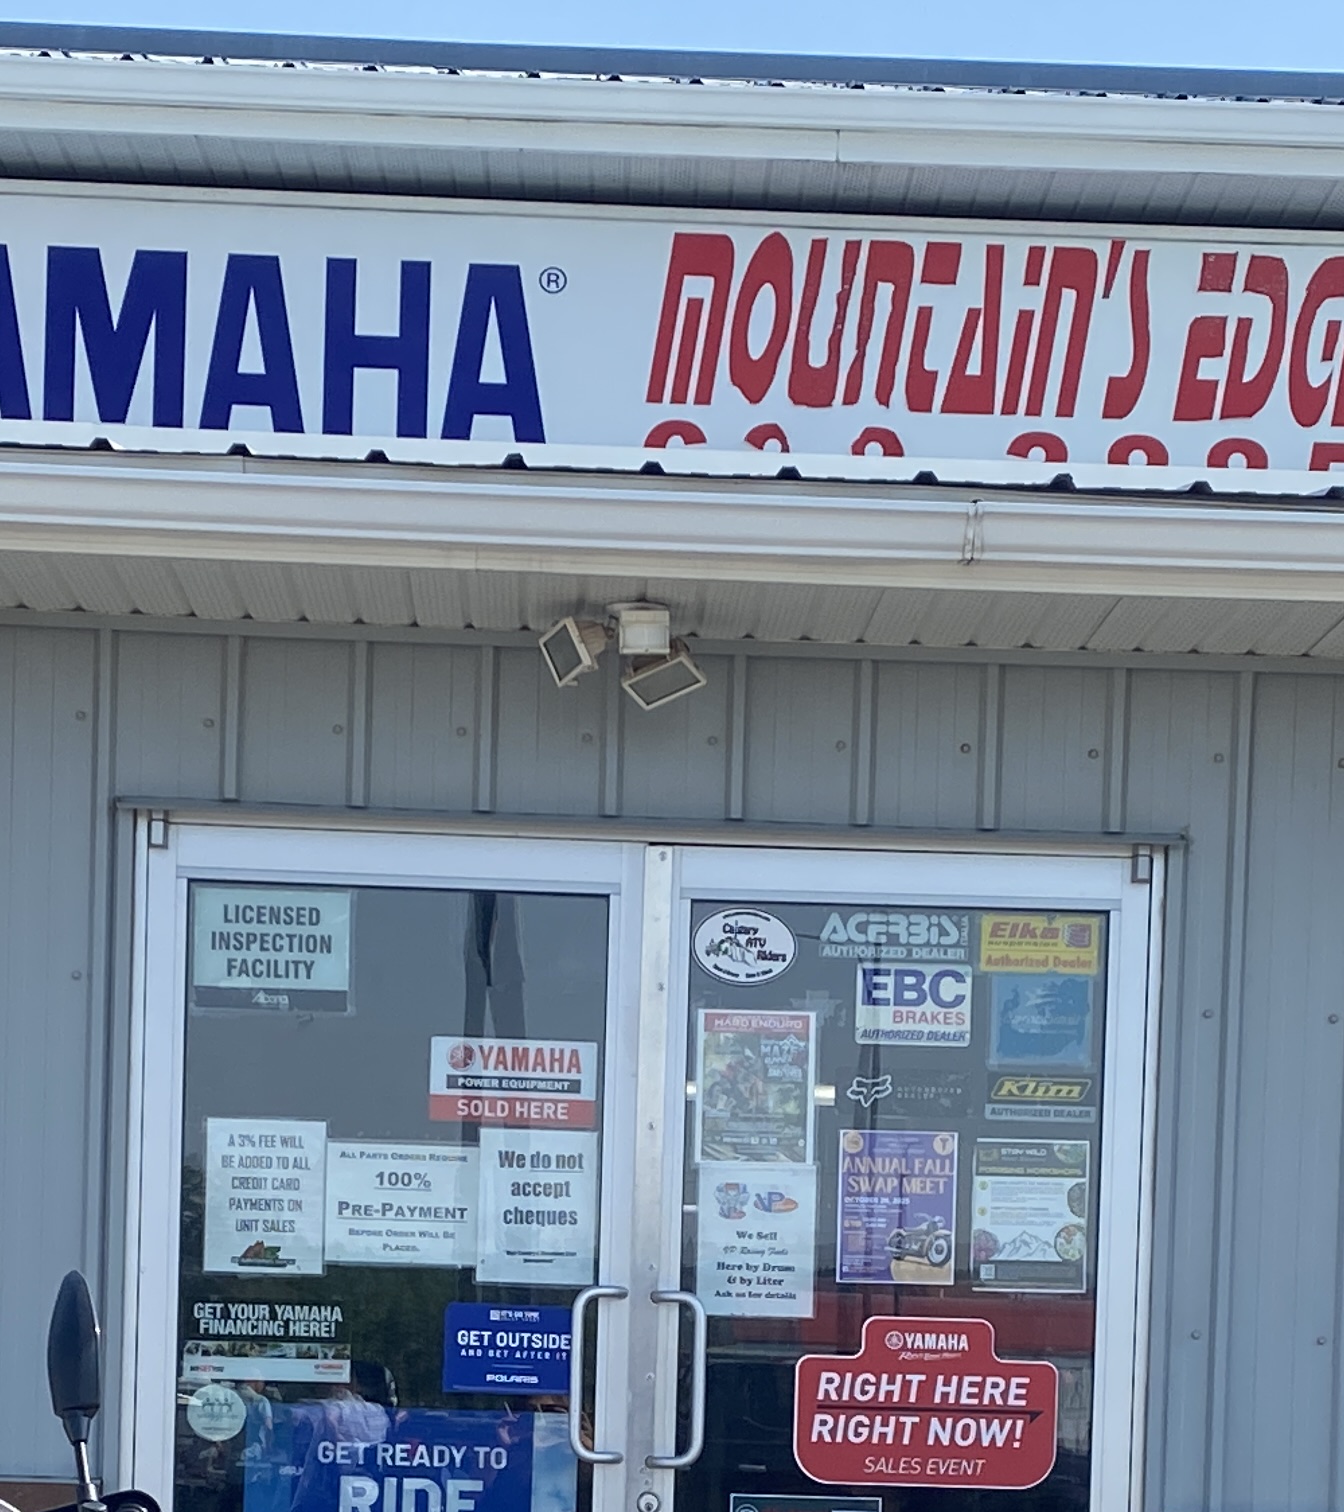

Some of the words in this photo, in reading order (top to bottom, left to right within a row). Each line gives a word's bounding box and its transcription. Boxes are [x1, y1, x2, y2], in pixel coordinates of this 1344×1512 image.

[223, 904, 321, 926] LICENSED
[819, 912, 960, 945] ACERBIS
[989, 921, 1061, 939] Elka
[211, 931, 332, 954] INSPECTION
[822, 946, 907, 958] AUTHORIZED
[912, 948, 966, 960] DEALER
[985, 954, 1050, 969] Authorized
[1053, 955, 1092, 970] Dealer
[227, 958, 315, 980] FACILITY
[861, 967, 967, 1009] EBC
[892, 1010, 966, 1026] BRAKES
[860, 1028, 924, 1041] AUTHORIZED
[926, 1030, 966, 1043] DEALER
[478, 1044, 582, 1074] YAMAHA
[457, 1078, 499, 1088] POWER
[502, 1079, 570, 1090] EQUIPMENT
[997, 1079, 1083, 1098] Klim
[456, 1099, 509, 1118] SOLD
[515, 1101, 570, 1120] HERE
[990, 1107, 1051, 1118] AUTHORIZED
[1053, 1108, 1091, 1118] DEALER
[228, 1134, 235, 1147] A
[238, 1134, 255, 1147] 3%
[258, 1134, 277, 1148] FEE
[280, 1135, 304, 1149] WILL
[221, 1154, 236, 1168] BE
[238, 1155, 273, 1170] ADDED
[276, 1156, 289, 1170] TO
[292, 1156, 311, 1170] ALL
[498, 1150, 526, 1168] We
[530, 1151, 551, 1169] do
[556, 1152, 584, 1170] not
[842, 1156, 911, 1175] ANNUAL
[914, 1158, 954, 1176] FALL
[231, 1176, 269, 1190] CREDIT
[271, 1177, 300, 1191] CARD
[375, 1171, 432, 1189] 100%
[847, 1177, 898, 1194] SWAP
[902, 1177, 949, 1195] MEET
[511, 1181, 571, 1199] accept
[229, 1197, 284, 1212] PAYMENTS
[287, 1199, 303, 1213] ON
[236, 1218, 259, 1232] UNIT
[262, 1219, 296, 1233] SALES
[503, 1206, 578, 1227] cheques
[736, 1231, 754, 1240] We
[756, 1231, 778, 1241] Sell
[716, 1262, 743, 1271] Here
[746, 1262, 759, 1272] by
[739, 1276, 753, 1286] by
[756, 1276, 785, 1286] Liter
[714, 1289, 733, 1298] Ask
[764, 1291, 797, 1300] details
[193, 1302, 224, 1319] GET
[227, 1303, 270, 1320] YOUR
[274, 1304, 344, 1322] YAMAHA
[199, 1319, 284, 1337] FINANCING
[289, 1321, 336, 1338] HERE!
[457, 1330, 492, 1346] GET
[495, 1331, 572, 1350] OUTSIDE
[904, 1332, 969, 1351] YAMAHA
[460, 1349, 483, 1357] AND
[515, 1350, 551, 1360] AFTER
[485, 1374, 539, 1384] POLARIS
[816, 1371, 926, 1402] RIGHT
[933, 1375, 1031, 1407] HERE
[810, 1413, 920, 1445] RIGHT
[926, 1417, 1024, 1448] NOW!
[317, 1441, 370, 1464] GET
[376, 1443, 466, 1468] READY
[473, 1446, 507, 1470] TO
[863, 1456, 921, 1474] SALES
[925, 1458, 986, 1476] EVENT
